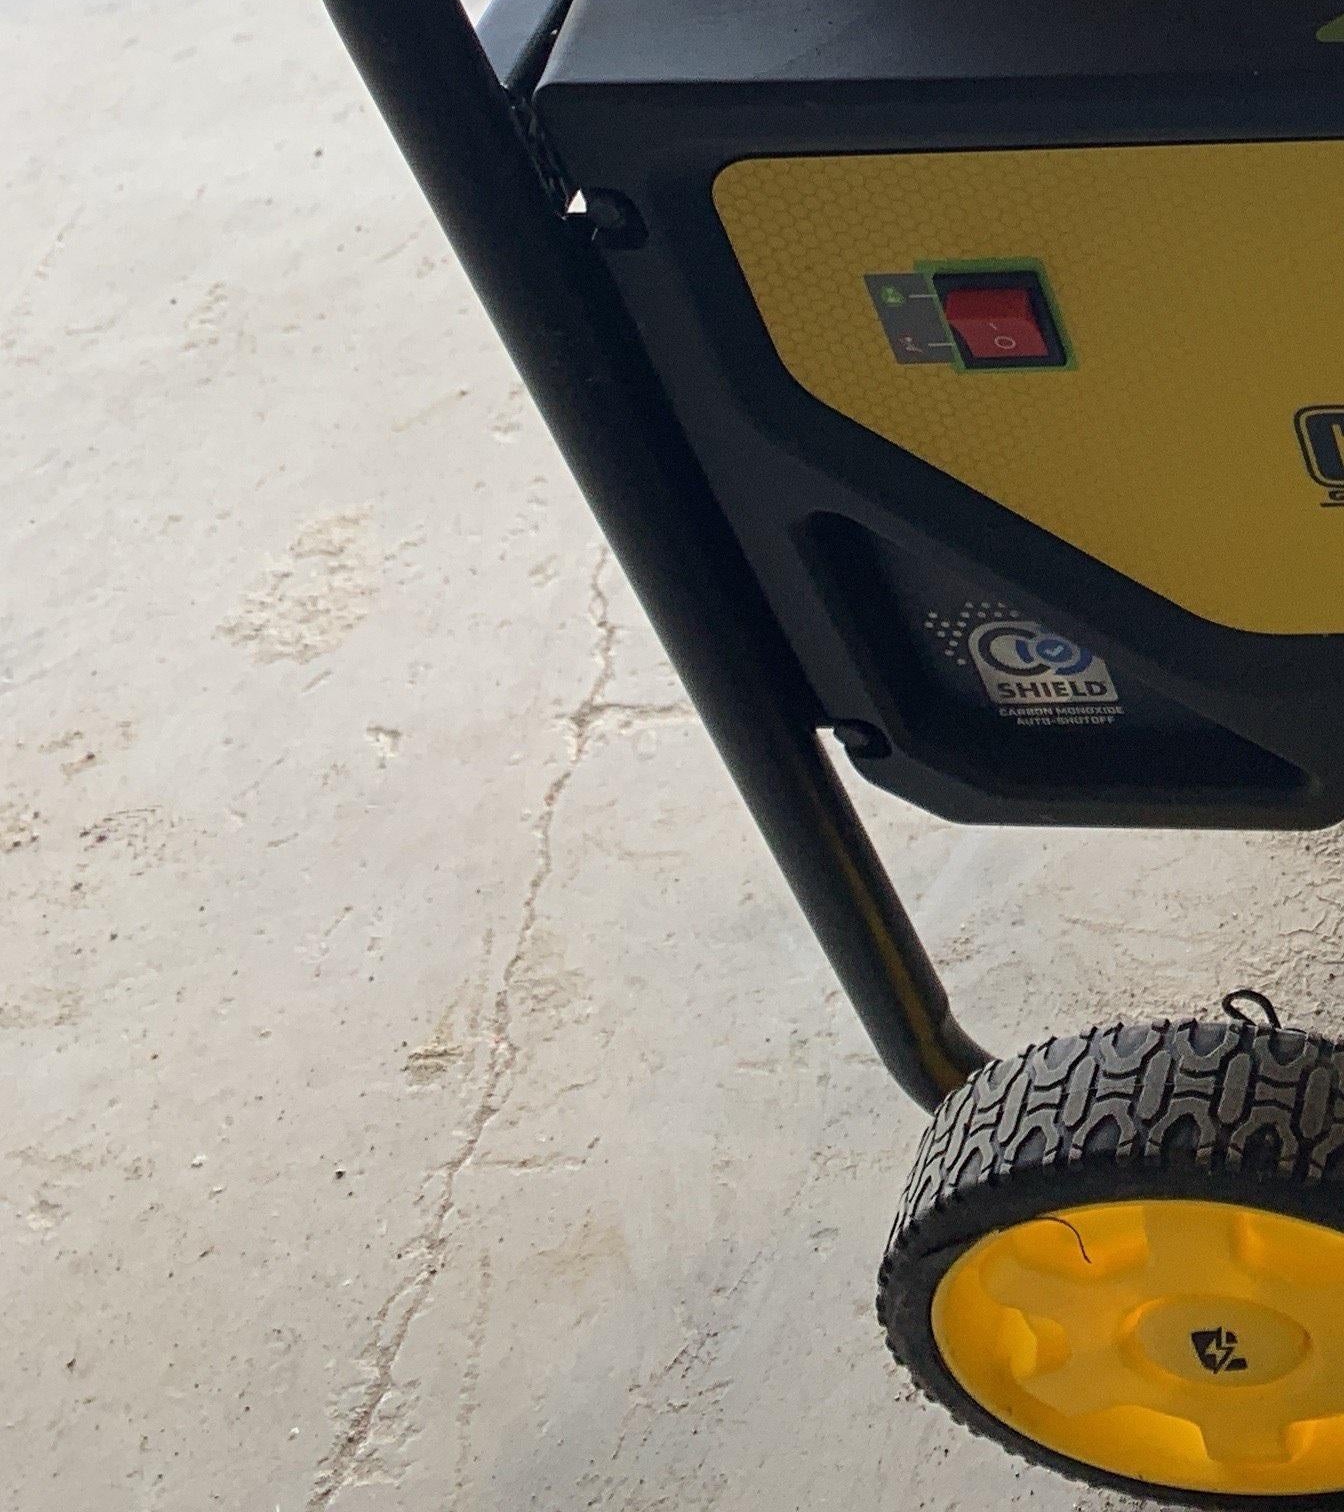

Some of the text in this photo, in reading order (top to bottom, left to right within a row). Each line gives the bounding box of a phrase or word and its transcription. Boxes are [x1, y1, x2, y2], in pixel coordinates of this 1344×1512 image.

[997, 680, 1108, 699] SHIELD
[999, 705, 1125, 717] CARBON MONOXIDE
